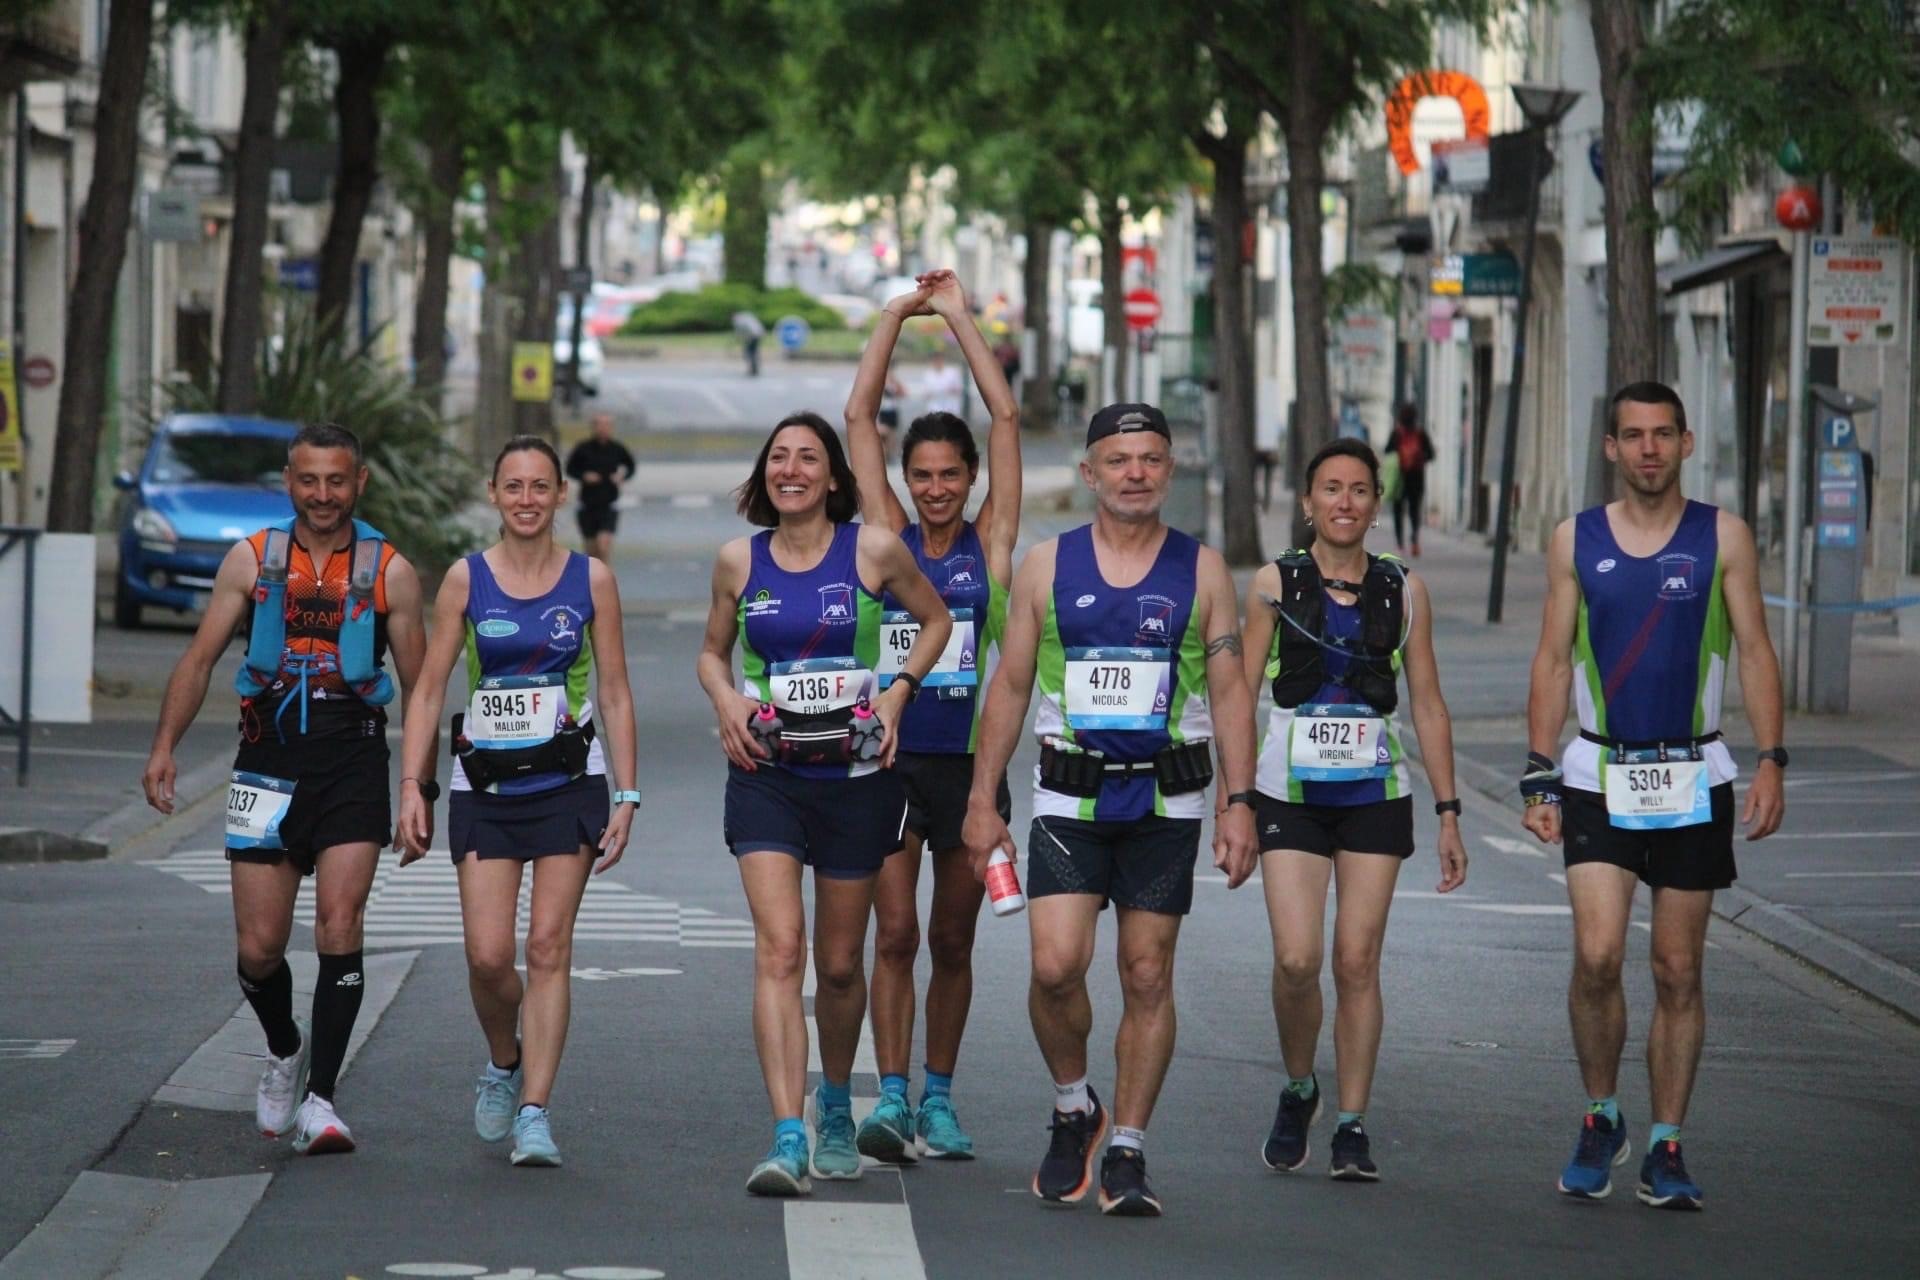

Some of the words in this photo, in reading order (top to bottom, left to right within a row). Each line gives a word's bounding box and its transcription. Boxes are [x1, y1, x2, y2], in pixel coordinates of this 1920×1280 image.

[1791, 198, 1809, 220] A
[1832, 417, 1850, 446] P
[823, 604, 848, 617] AXA
[1140, 617, 1165, 632] AXA
[788, 677, 829, 701] 2136
[836, 676, 845, 698] F
[1089, 667, 1131, 689] 4778
[949, 687, 967, 697] 4676
[1092, 695, 1128, 706] NICOLAS
[481, 694, 526, 716] 3945
[532, 693, 541, 714] F
[494, 720, 531, 731] MALLORY
[1308, 723, 1350, 745] 4672
[1358, 724, 1366, 745] F
[1320, 750, 1353, 760] VIRGINIE
[1629, 769, 1672, 791] 5304
[228, 788, 258, 813] 2137
[1640, 796, 1663, 807] WILLY
